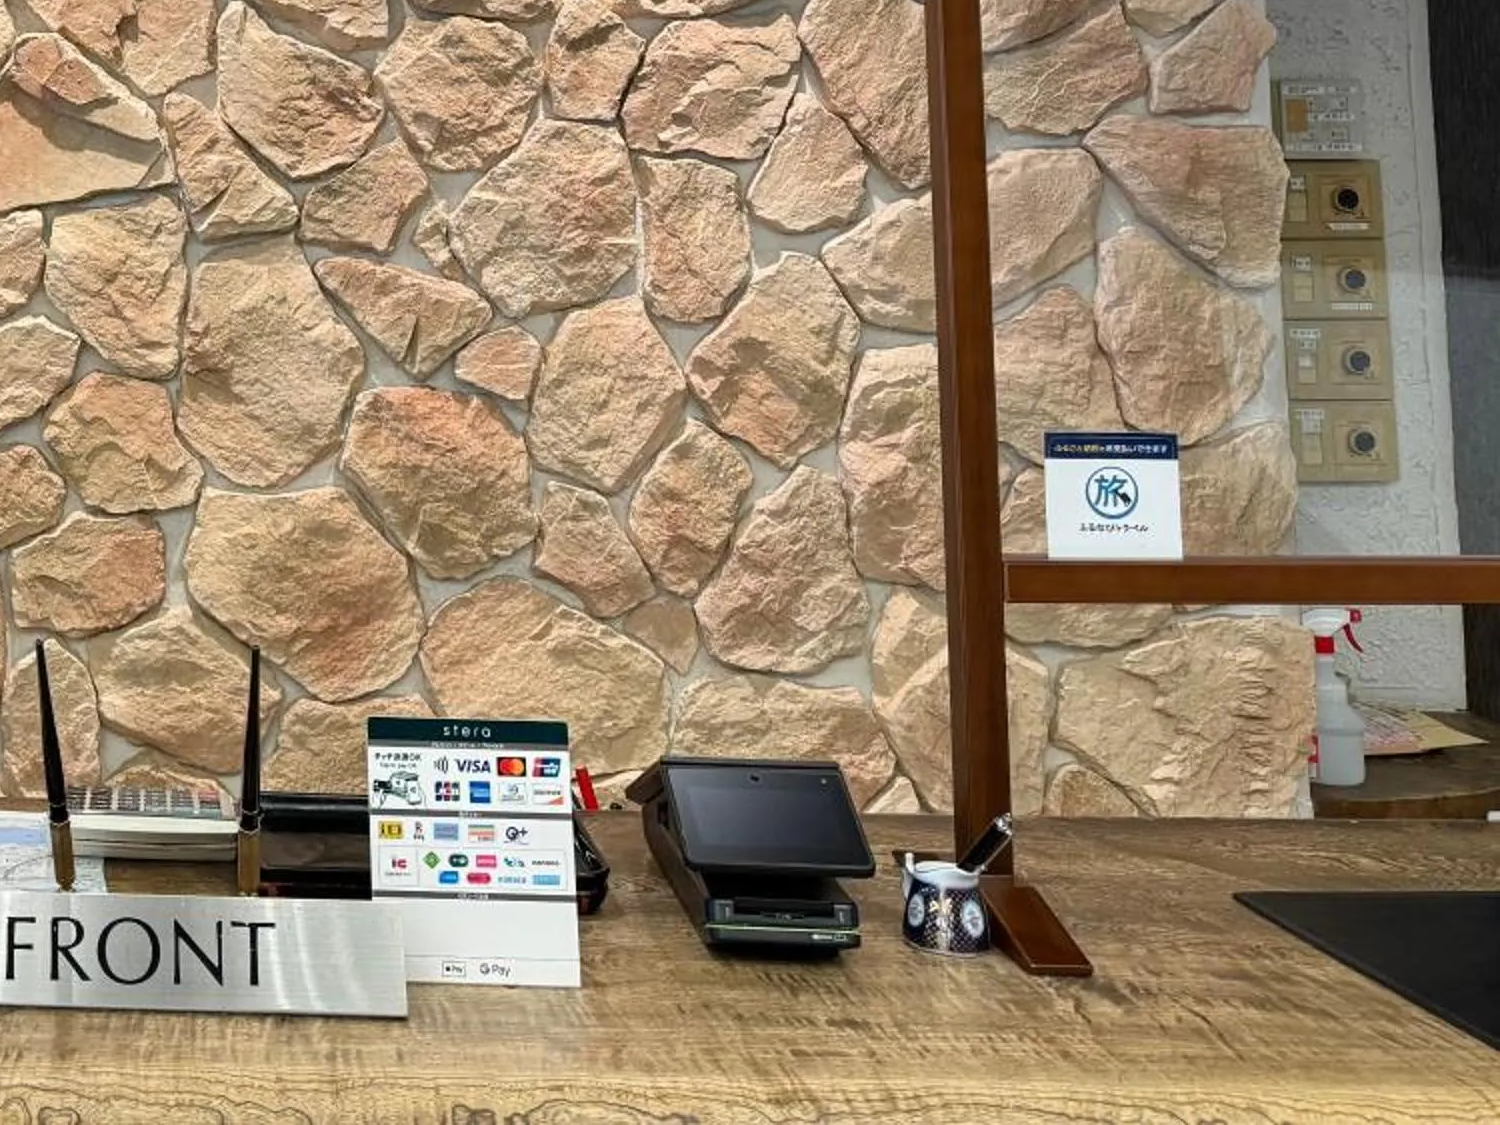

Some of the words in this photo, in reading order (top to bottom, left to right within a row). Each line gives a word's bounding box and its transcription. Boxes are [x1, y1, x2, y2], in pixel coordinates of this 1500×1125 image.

[443, 725, 492, 738] stera
[455, 759, 492, 773] VISA
[6, 916, 276, 986] FRONT
